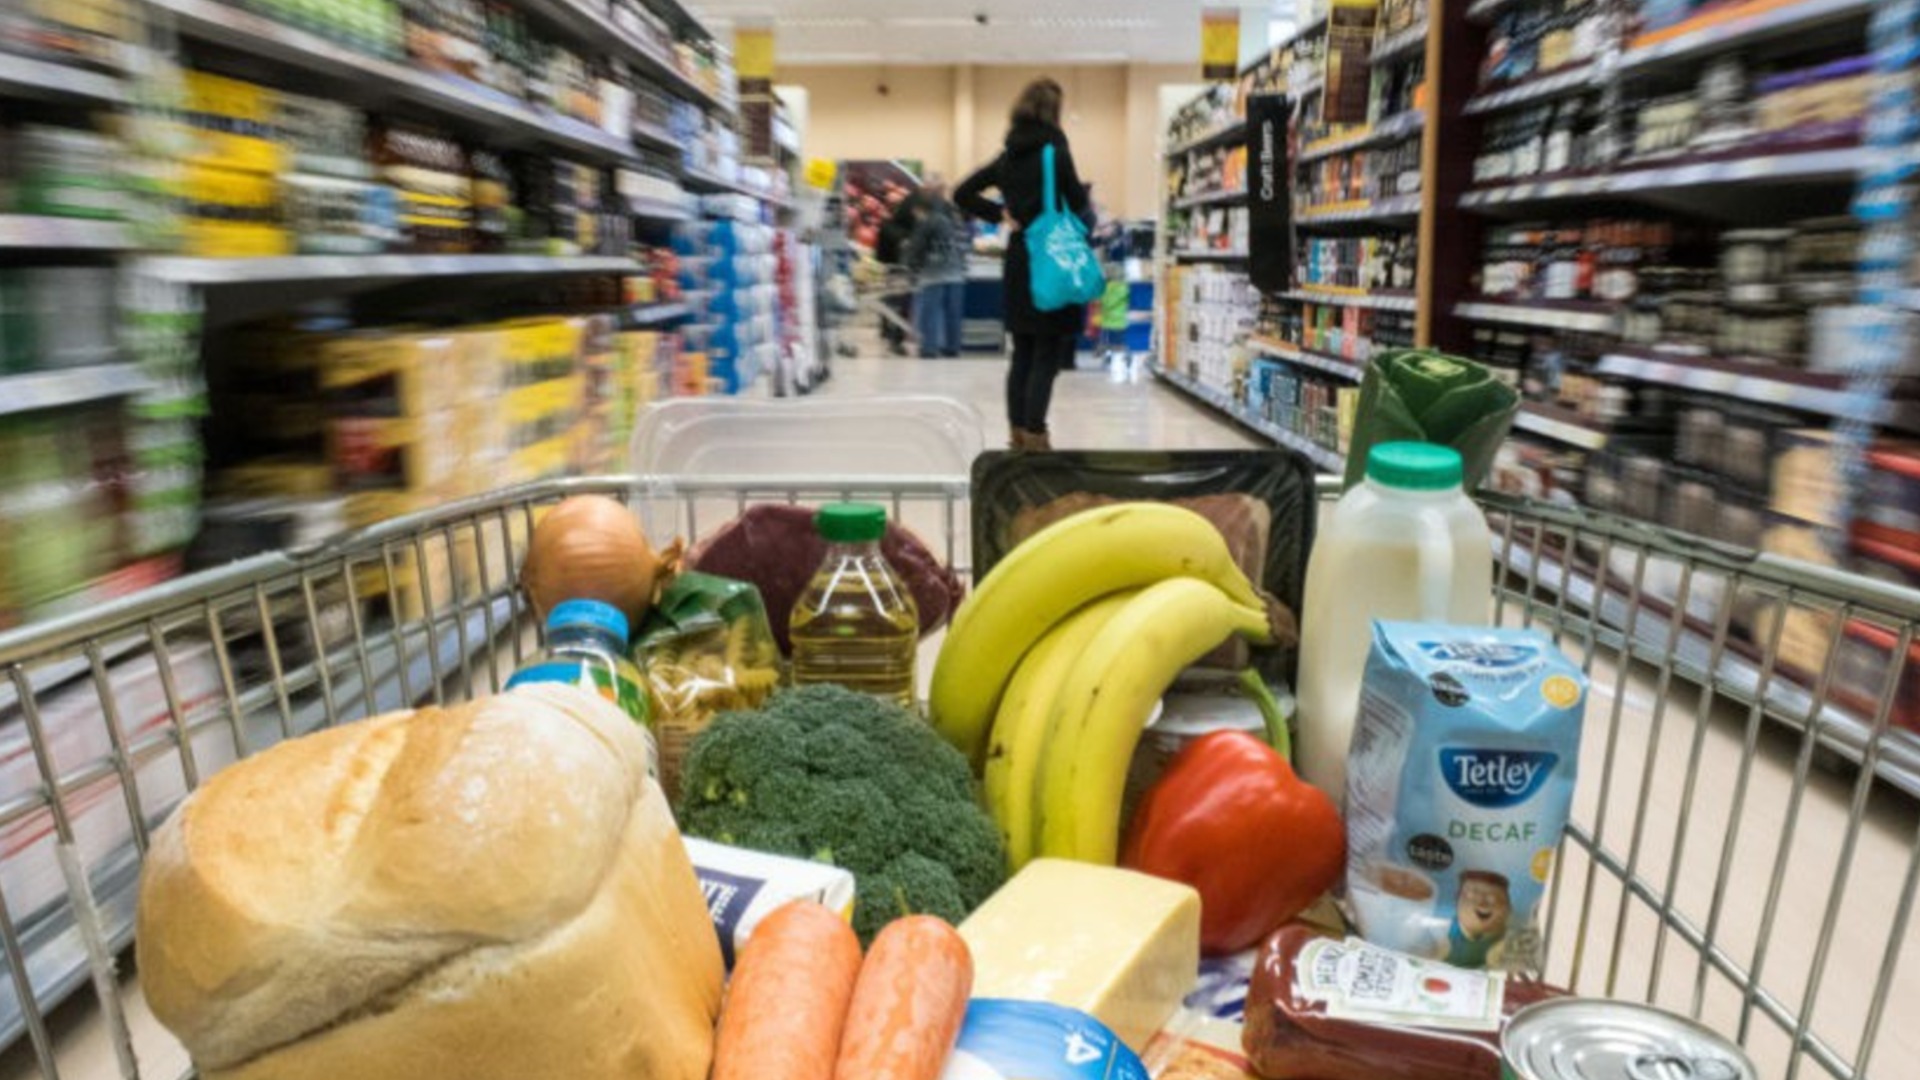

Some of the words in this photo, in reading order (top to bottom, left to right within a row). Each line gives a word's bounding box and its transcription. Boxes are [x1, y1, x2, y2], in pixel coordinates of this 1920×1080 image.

[1453, 754, 1541, 795] Tetley
[1448, 820, 1537, 842] DECAF
[1064, 1032, 1102, 1065] 4
